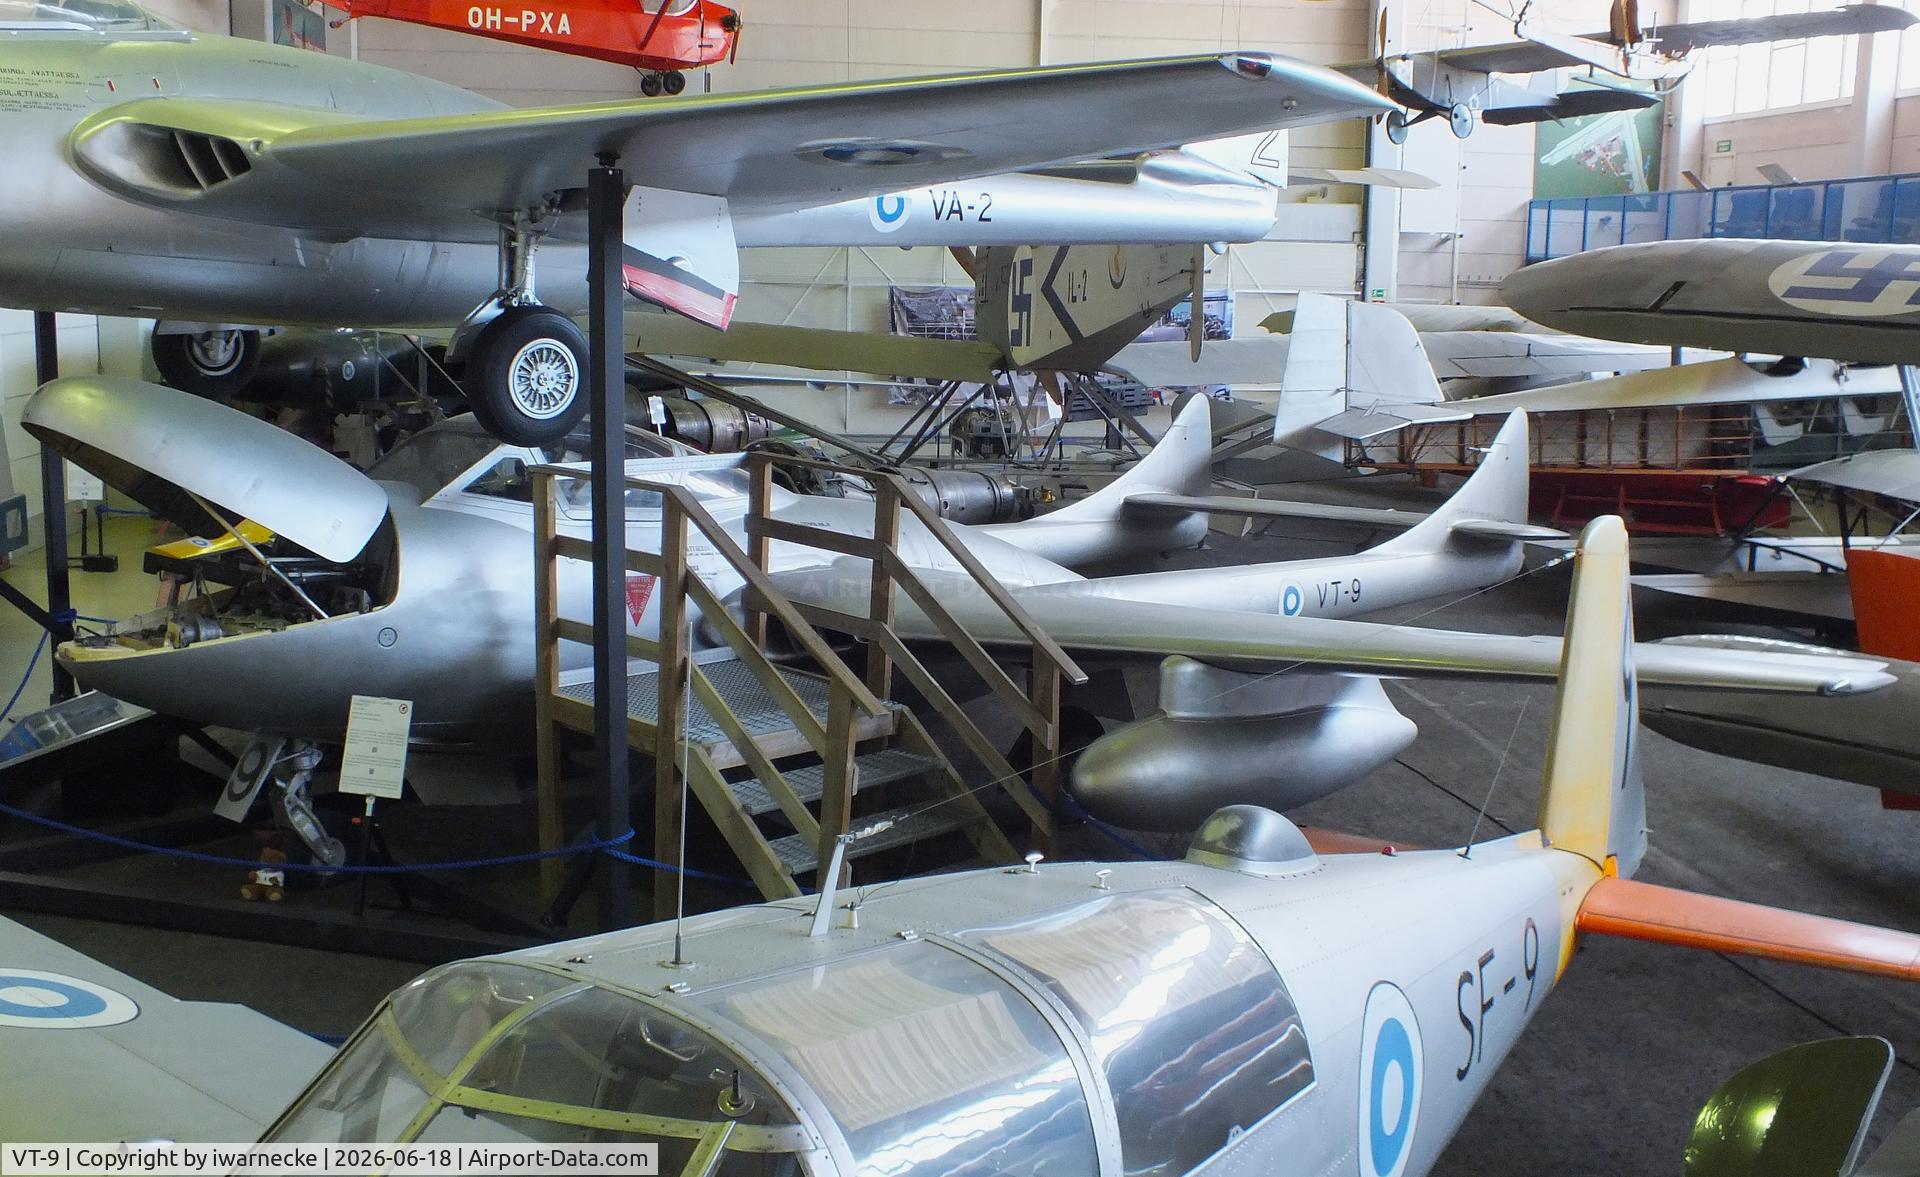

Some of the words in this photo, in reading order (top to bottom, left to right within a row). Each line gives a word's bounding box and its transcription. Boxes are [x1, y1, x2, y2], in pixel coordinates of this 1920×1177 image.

[467, 6, 571, 35] OH-PXA
[928, 189, 992, 222] VA-2
[1067, 269, 1088, 304] IL-2
[1316, 578, 1361, 608] VT-9
[1456, 917, 1539, 1082] SF-9
